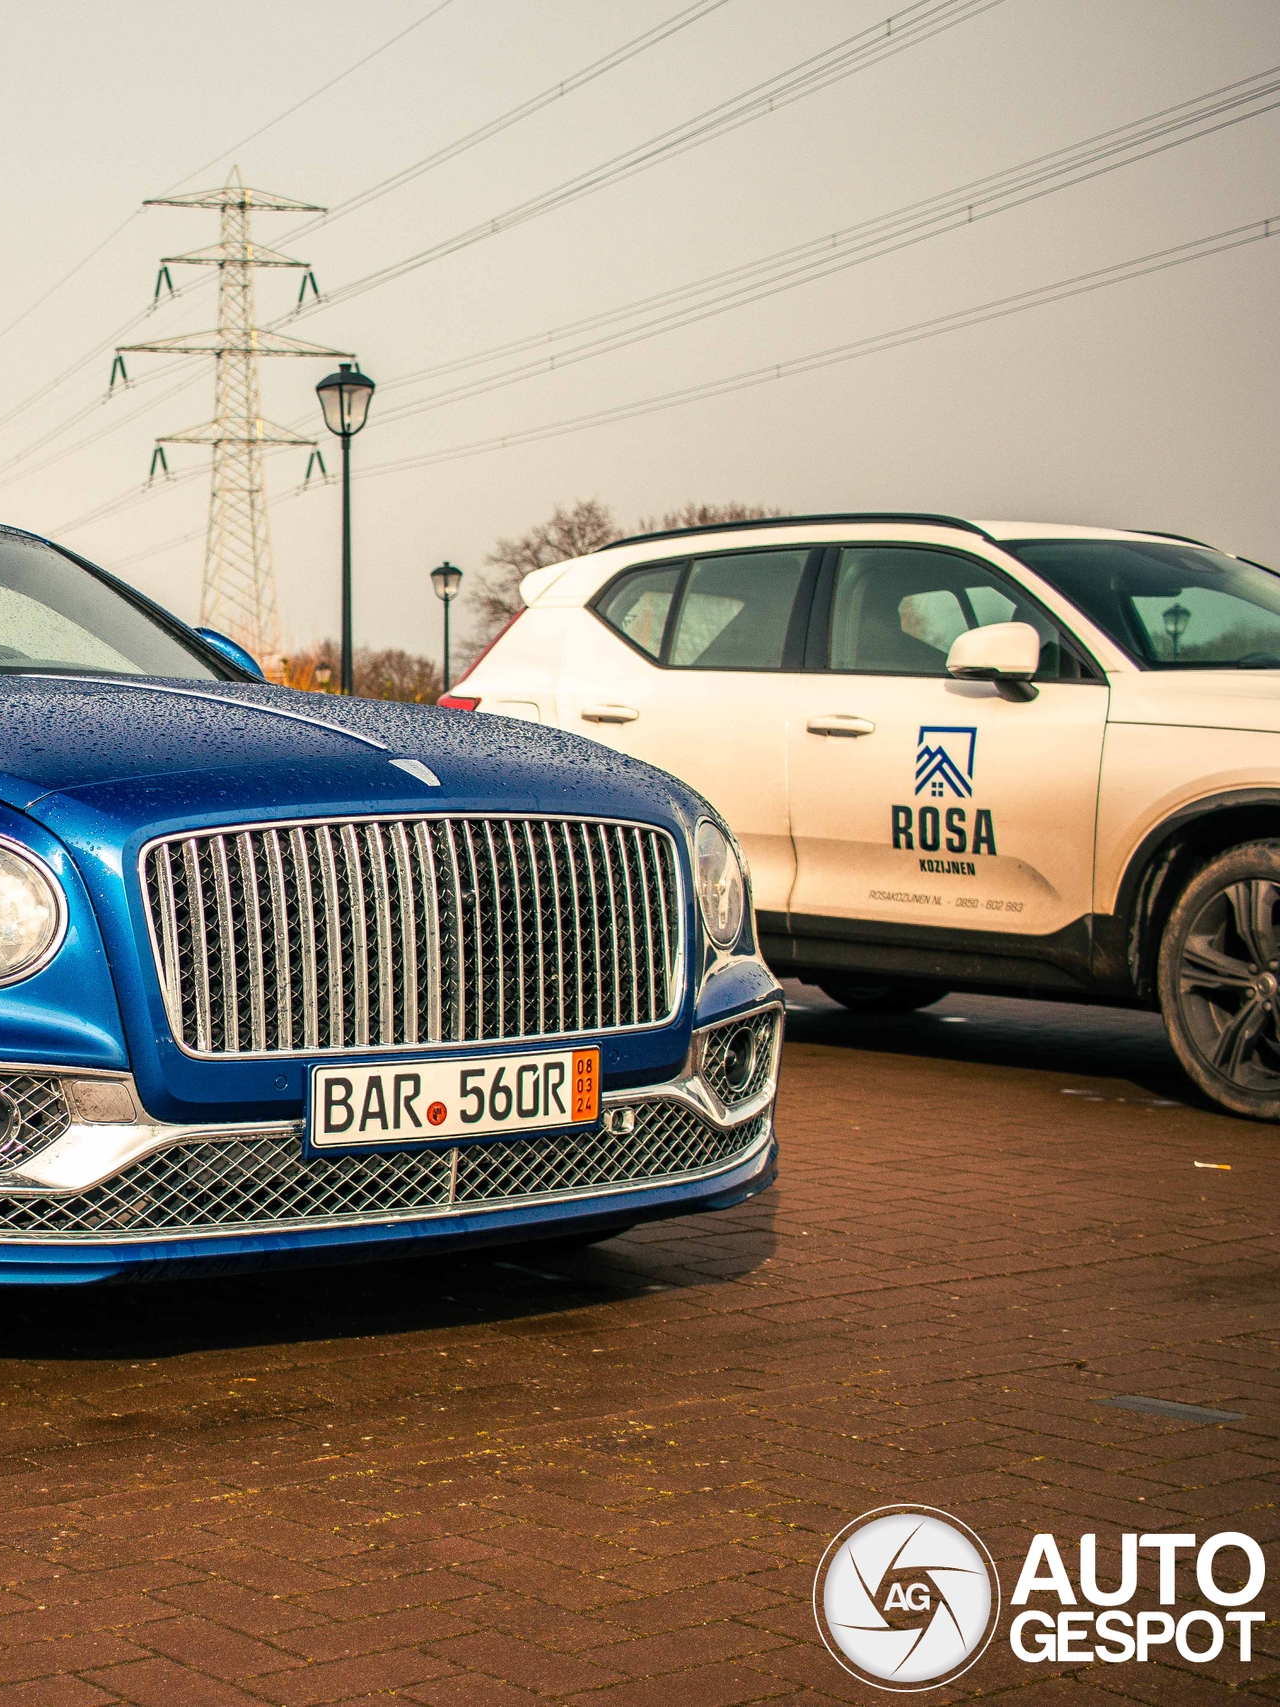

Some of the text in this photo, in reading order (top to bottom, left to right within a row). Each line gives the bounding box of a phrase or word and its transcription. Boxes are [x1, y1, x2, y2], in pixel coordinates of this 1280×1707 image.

[891, 804, 998, 856] ROSA
[919, 858, 977, 876] KOZIJNEN
[577, 1058, 593, 1075] 08
[577, 1077, 593, 1093] 03
[324, 1073, 423, 1134] BAR
[576, 1096, 592, 1113] 24
